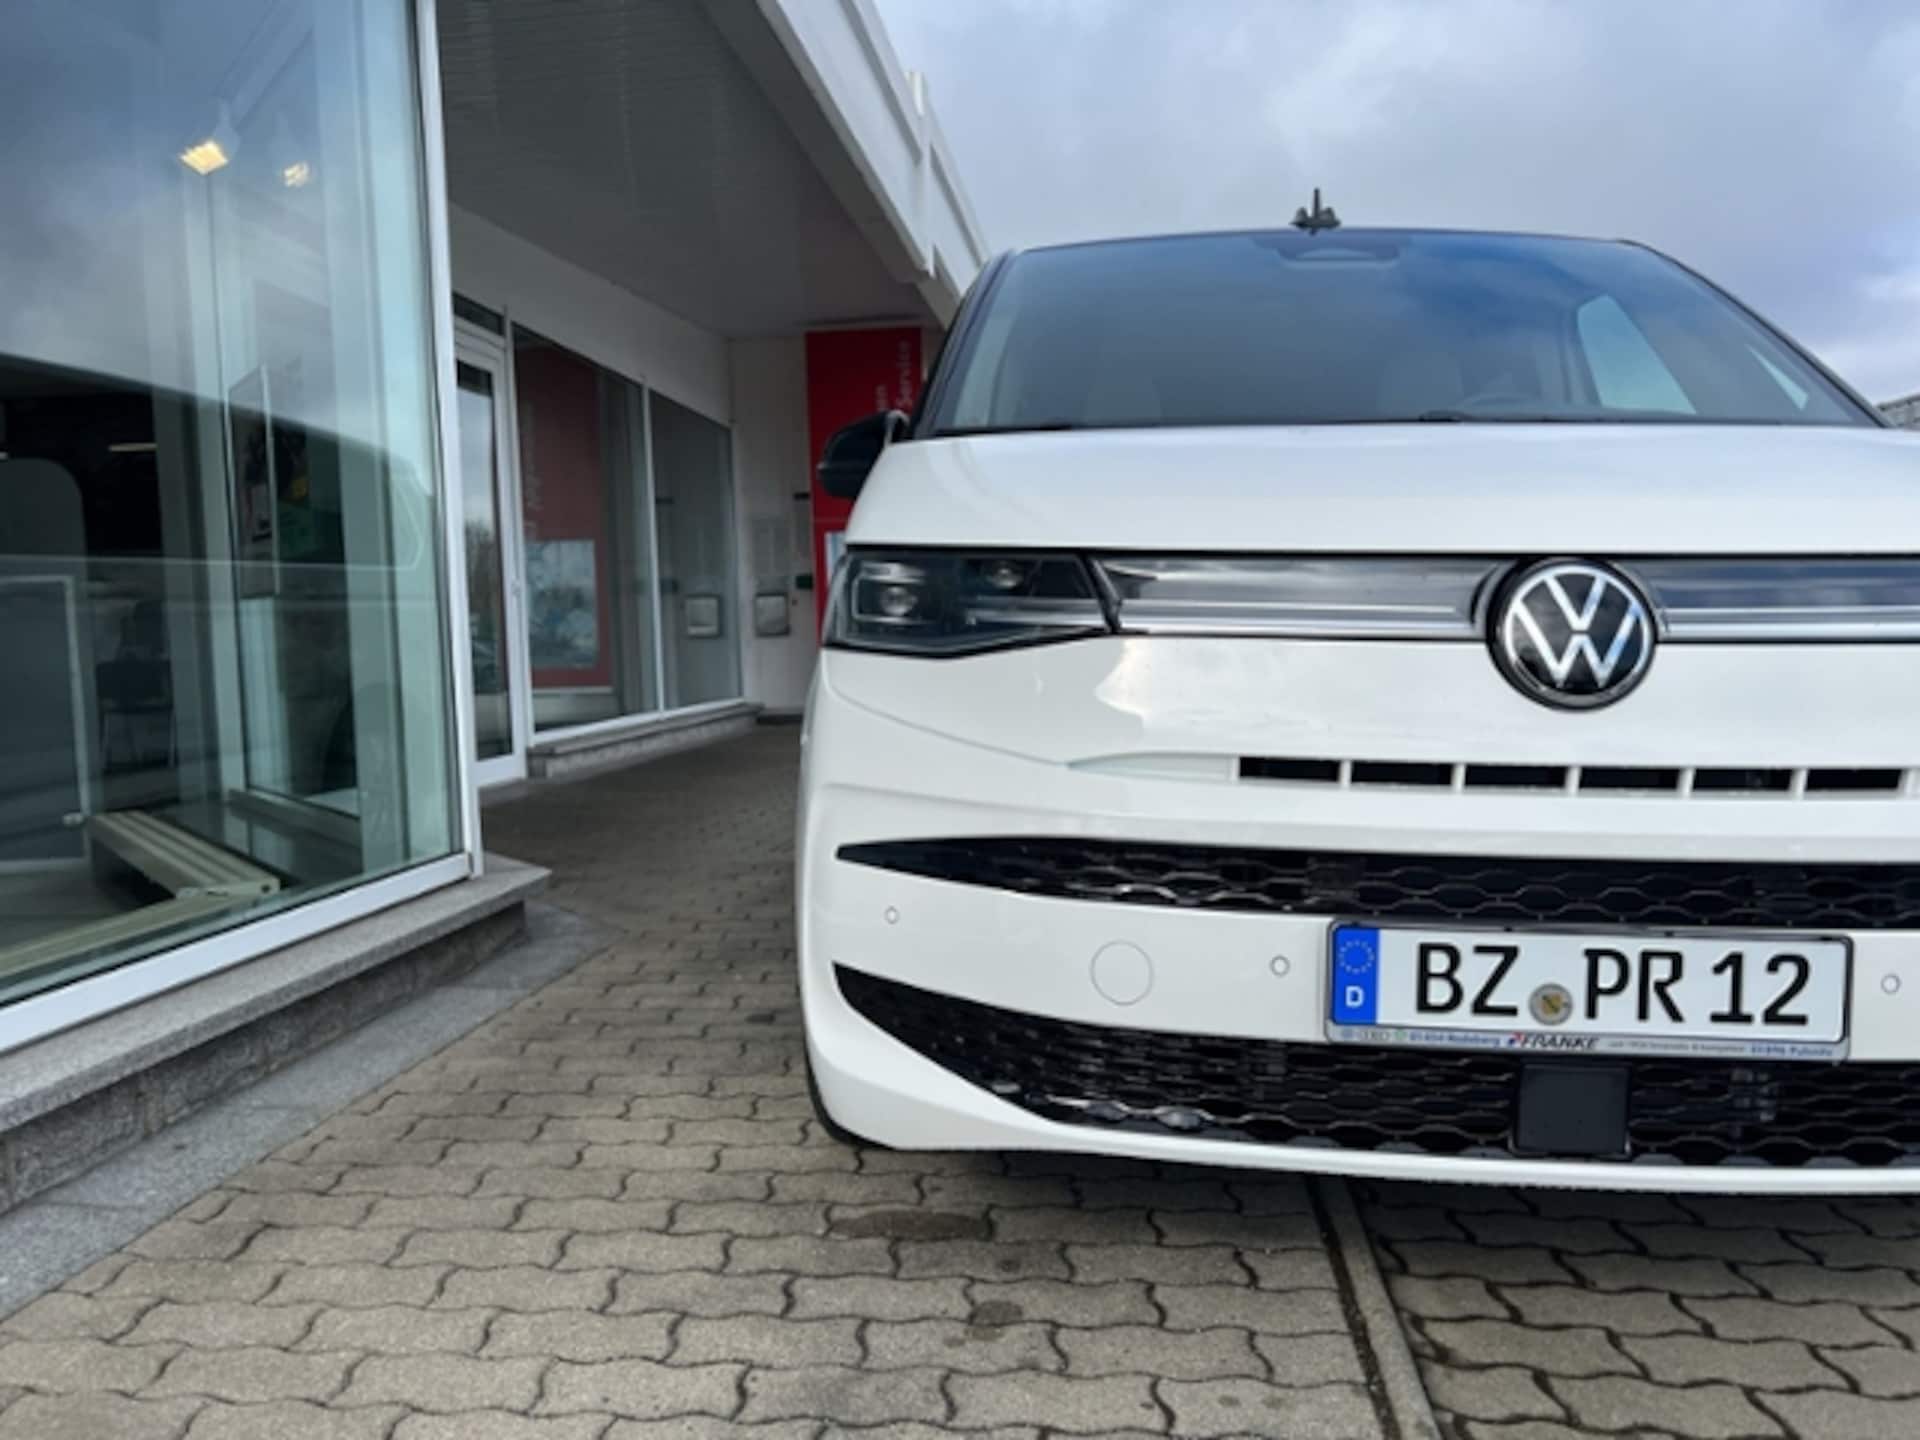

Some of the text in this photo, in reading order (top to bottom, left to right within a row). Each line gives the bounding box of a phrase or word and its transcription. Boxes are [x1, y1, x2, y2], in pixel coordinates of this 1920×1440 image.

[1507, 567, 1648, 692] VW
[1345, 985, 1364, 1007] D
[1416, 942, 1811, 1026] BZ PR 12
[1519, 1034, 1600, 1050] FRANKE
